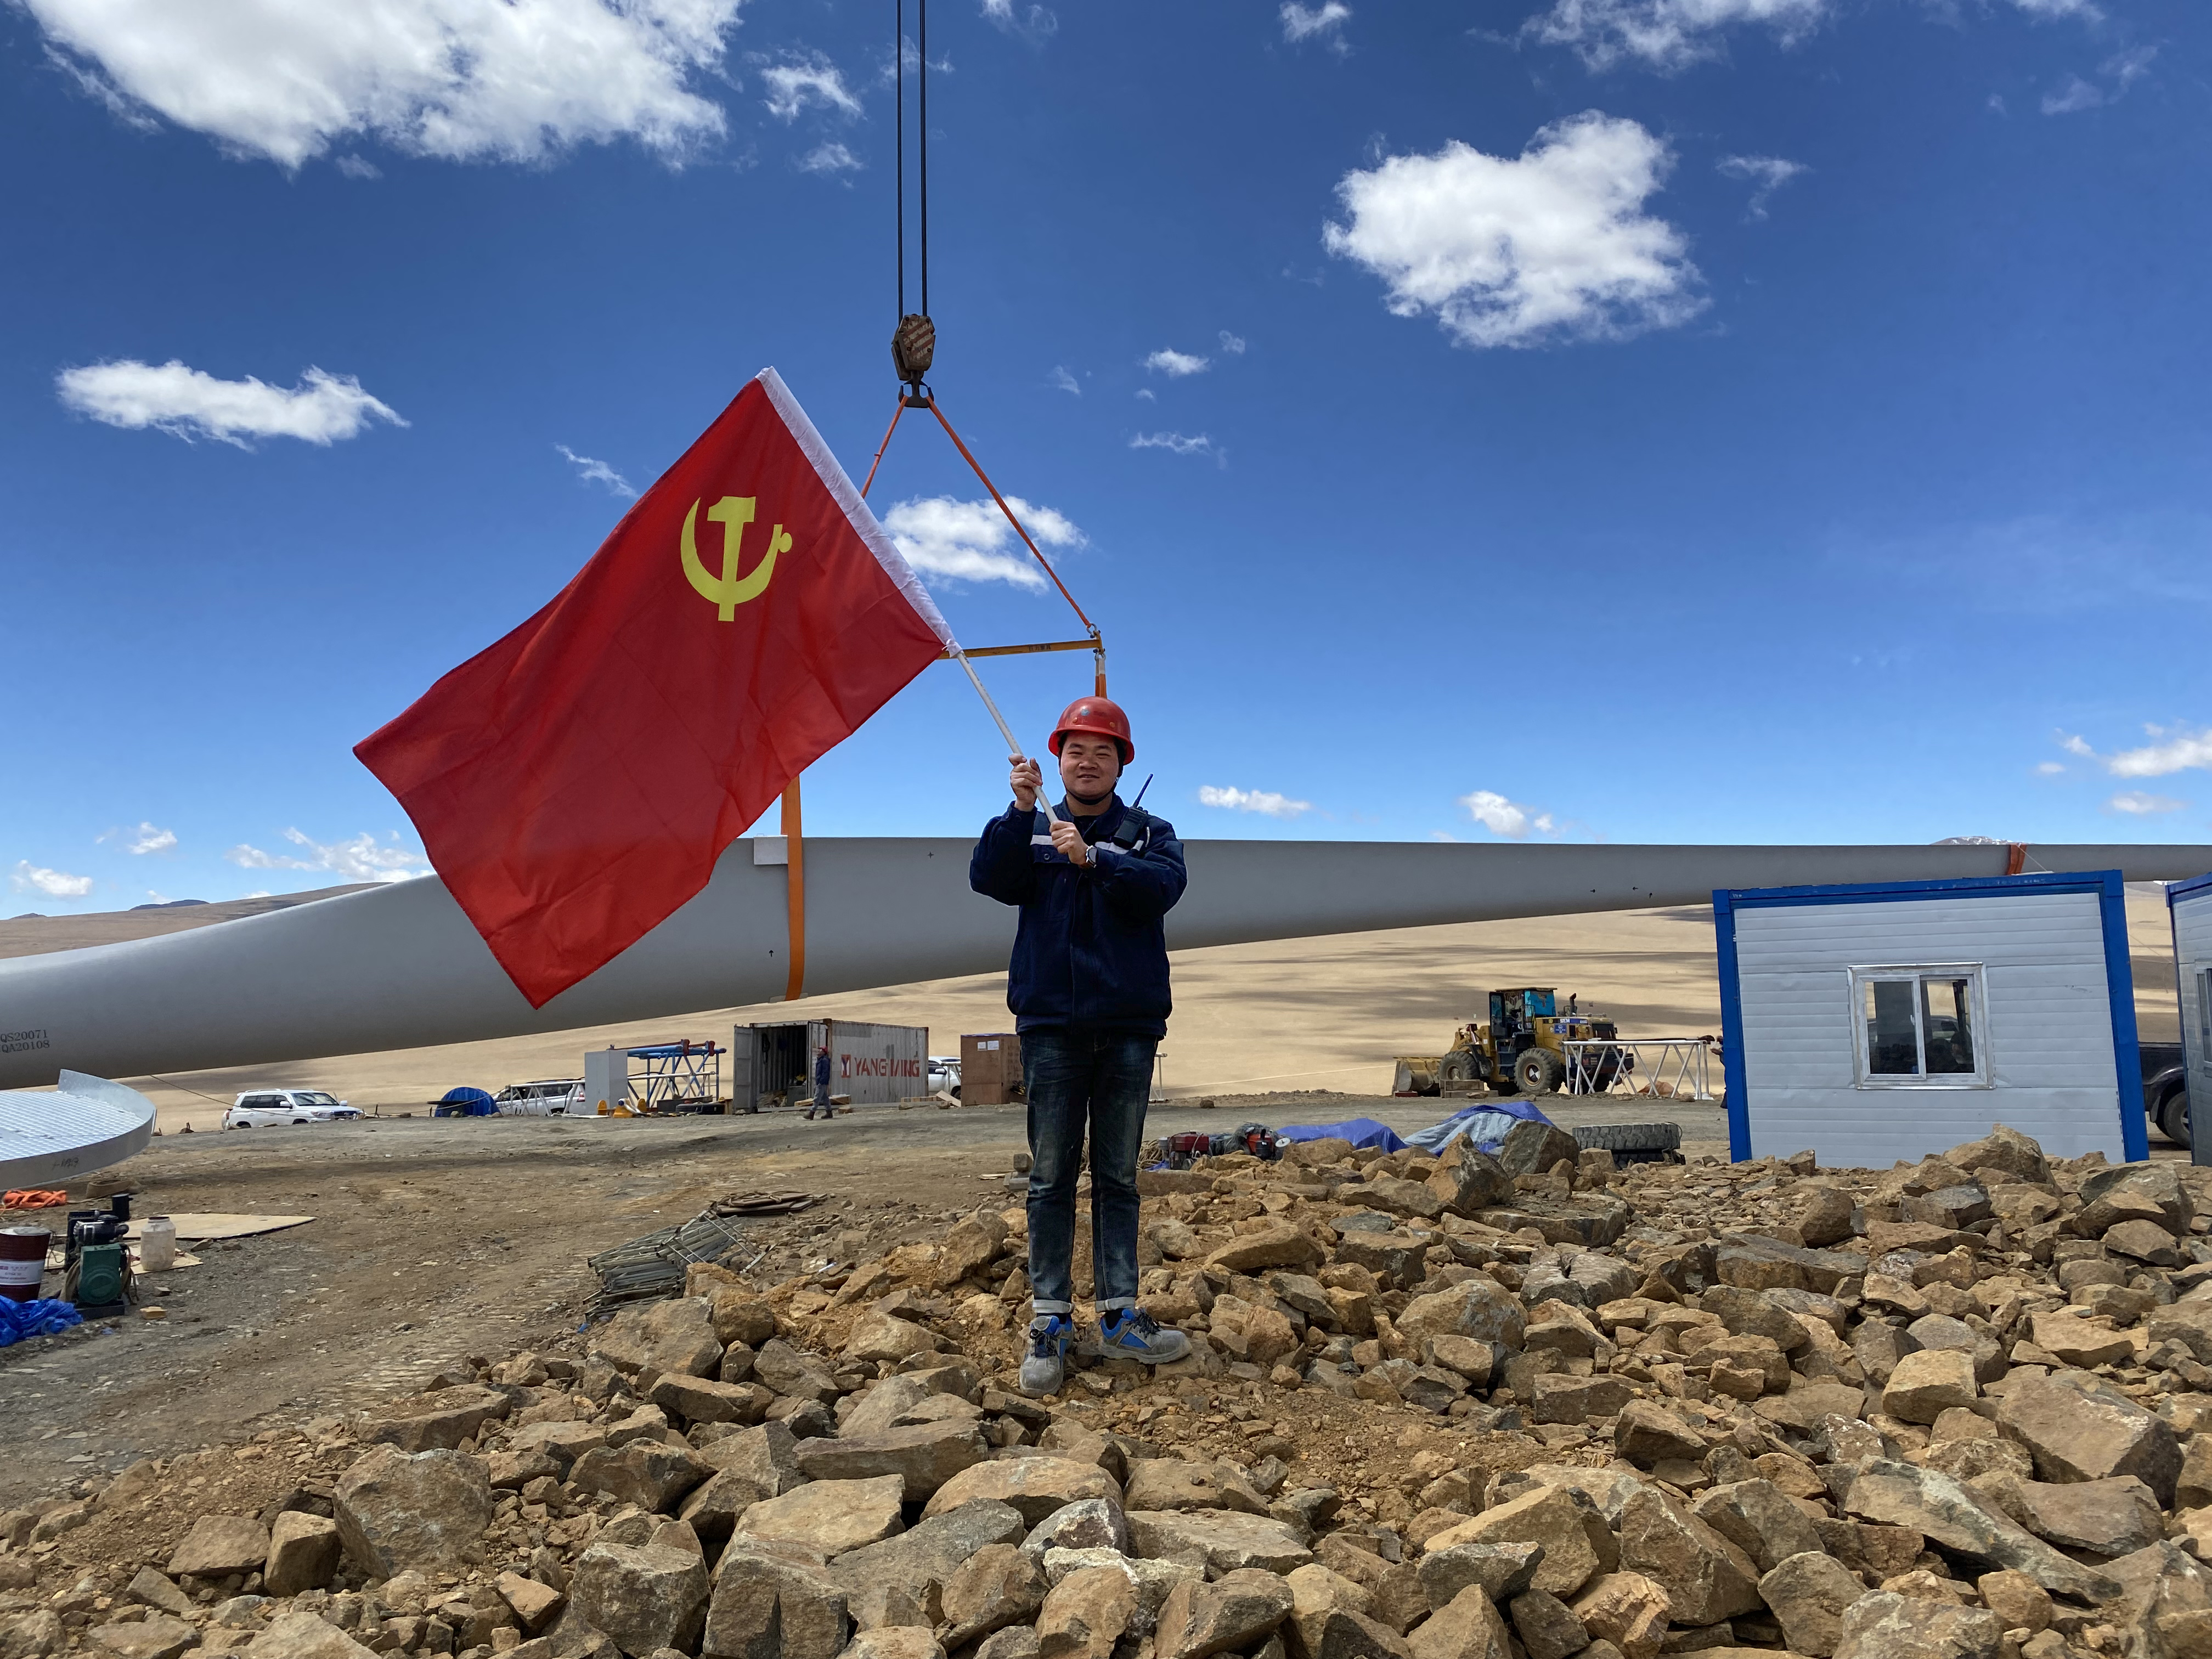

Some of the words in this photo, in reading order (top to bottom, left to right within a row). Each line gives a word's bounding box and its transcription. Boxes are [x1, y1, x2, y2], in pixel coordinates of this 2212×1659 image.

[0, 1040, 50, 1053] QA20108
[854, 1057, 887, 1076] YANG
[890, 1059, 919, 1077] MING
